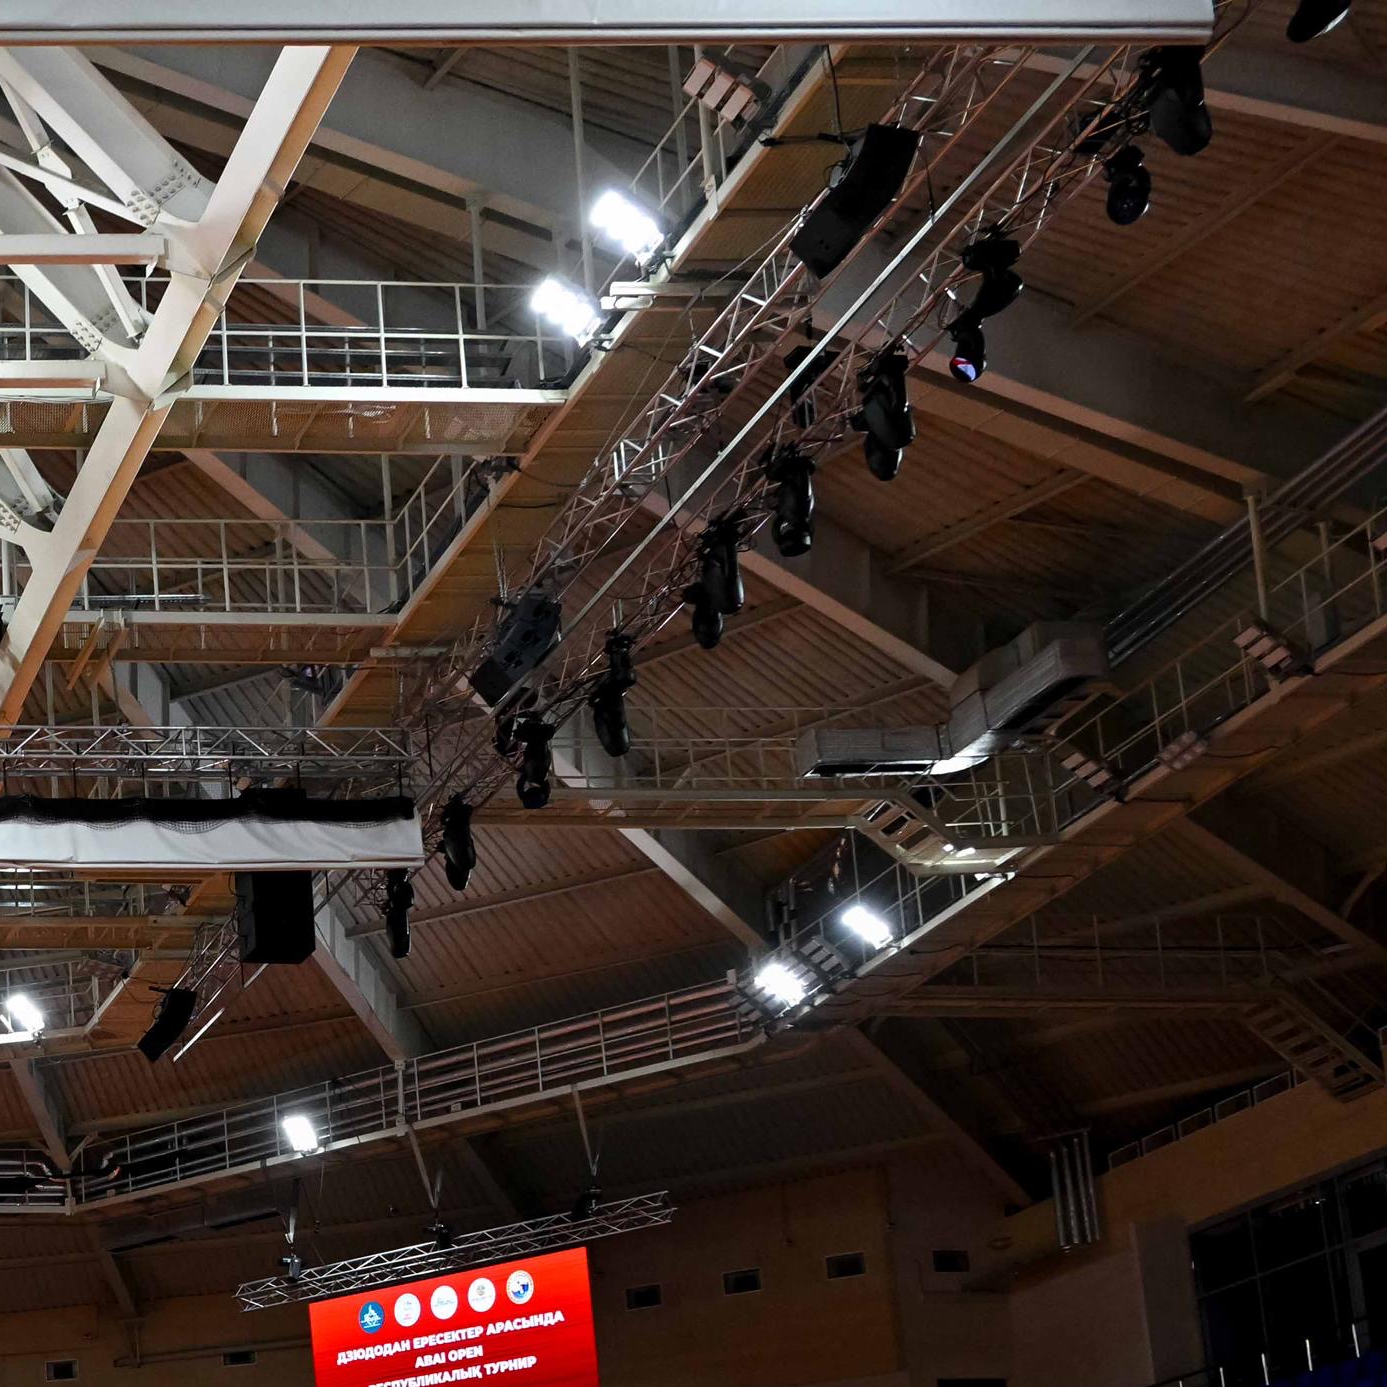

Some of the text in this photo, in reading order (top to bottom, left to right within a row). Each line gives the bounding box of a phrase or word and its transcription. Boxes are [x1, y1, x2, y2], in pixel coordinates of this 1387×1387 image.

[337, 1310, 565, 1365] ДЗЮДОДАН ЕРЕСЕКТЕР АРАСЫНДА
[415, 1345, 484, 1368] ABAI OPEN
[484, 1356, 537, 1375] ТУРНИР
